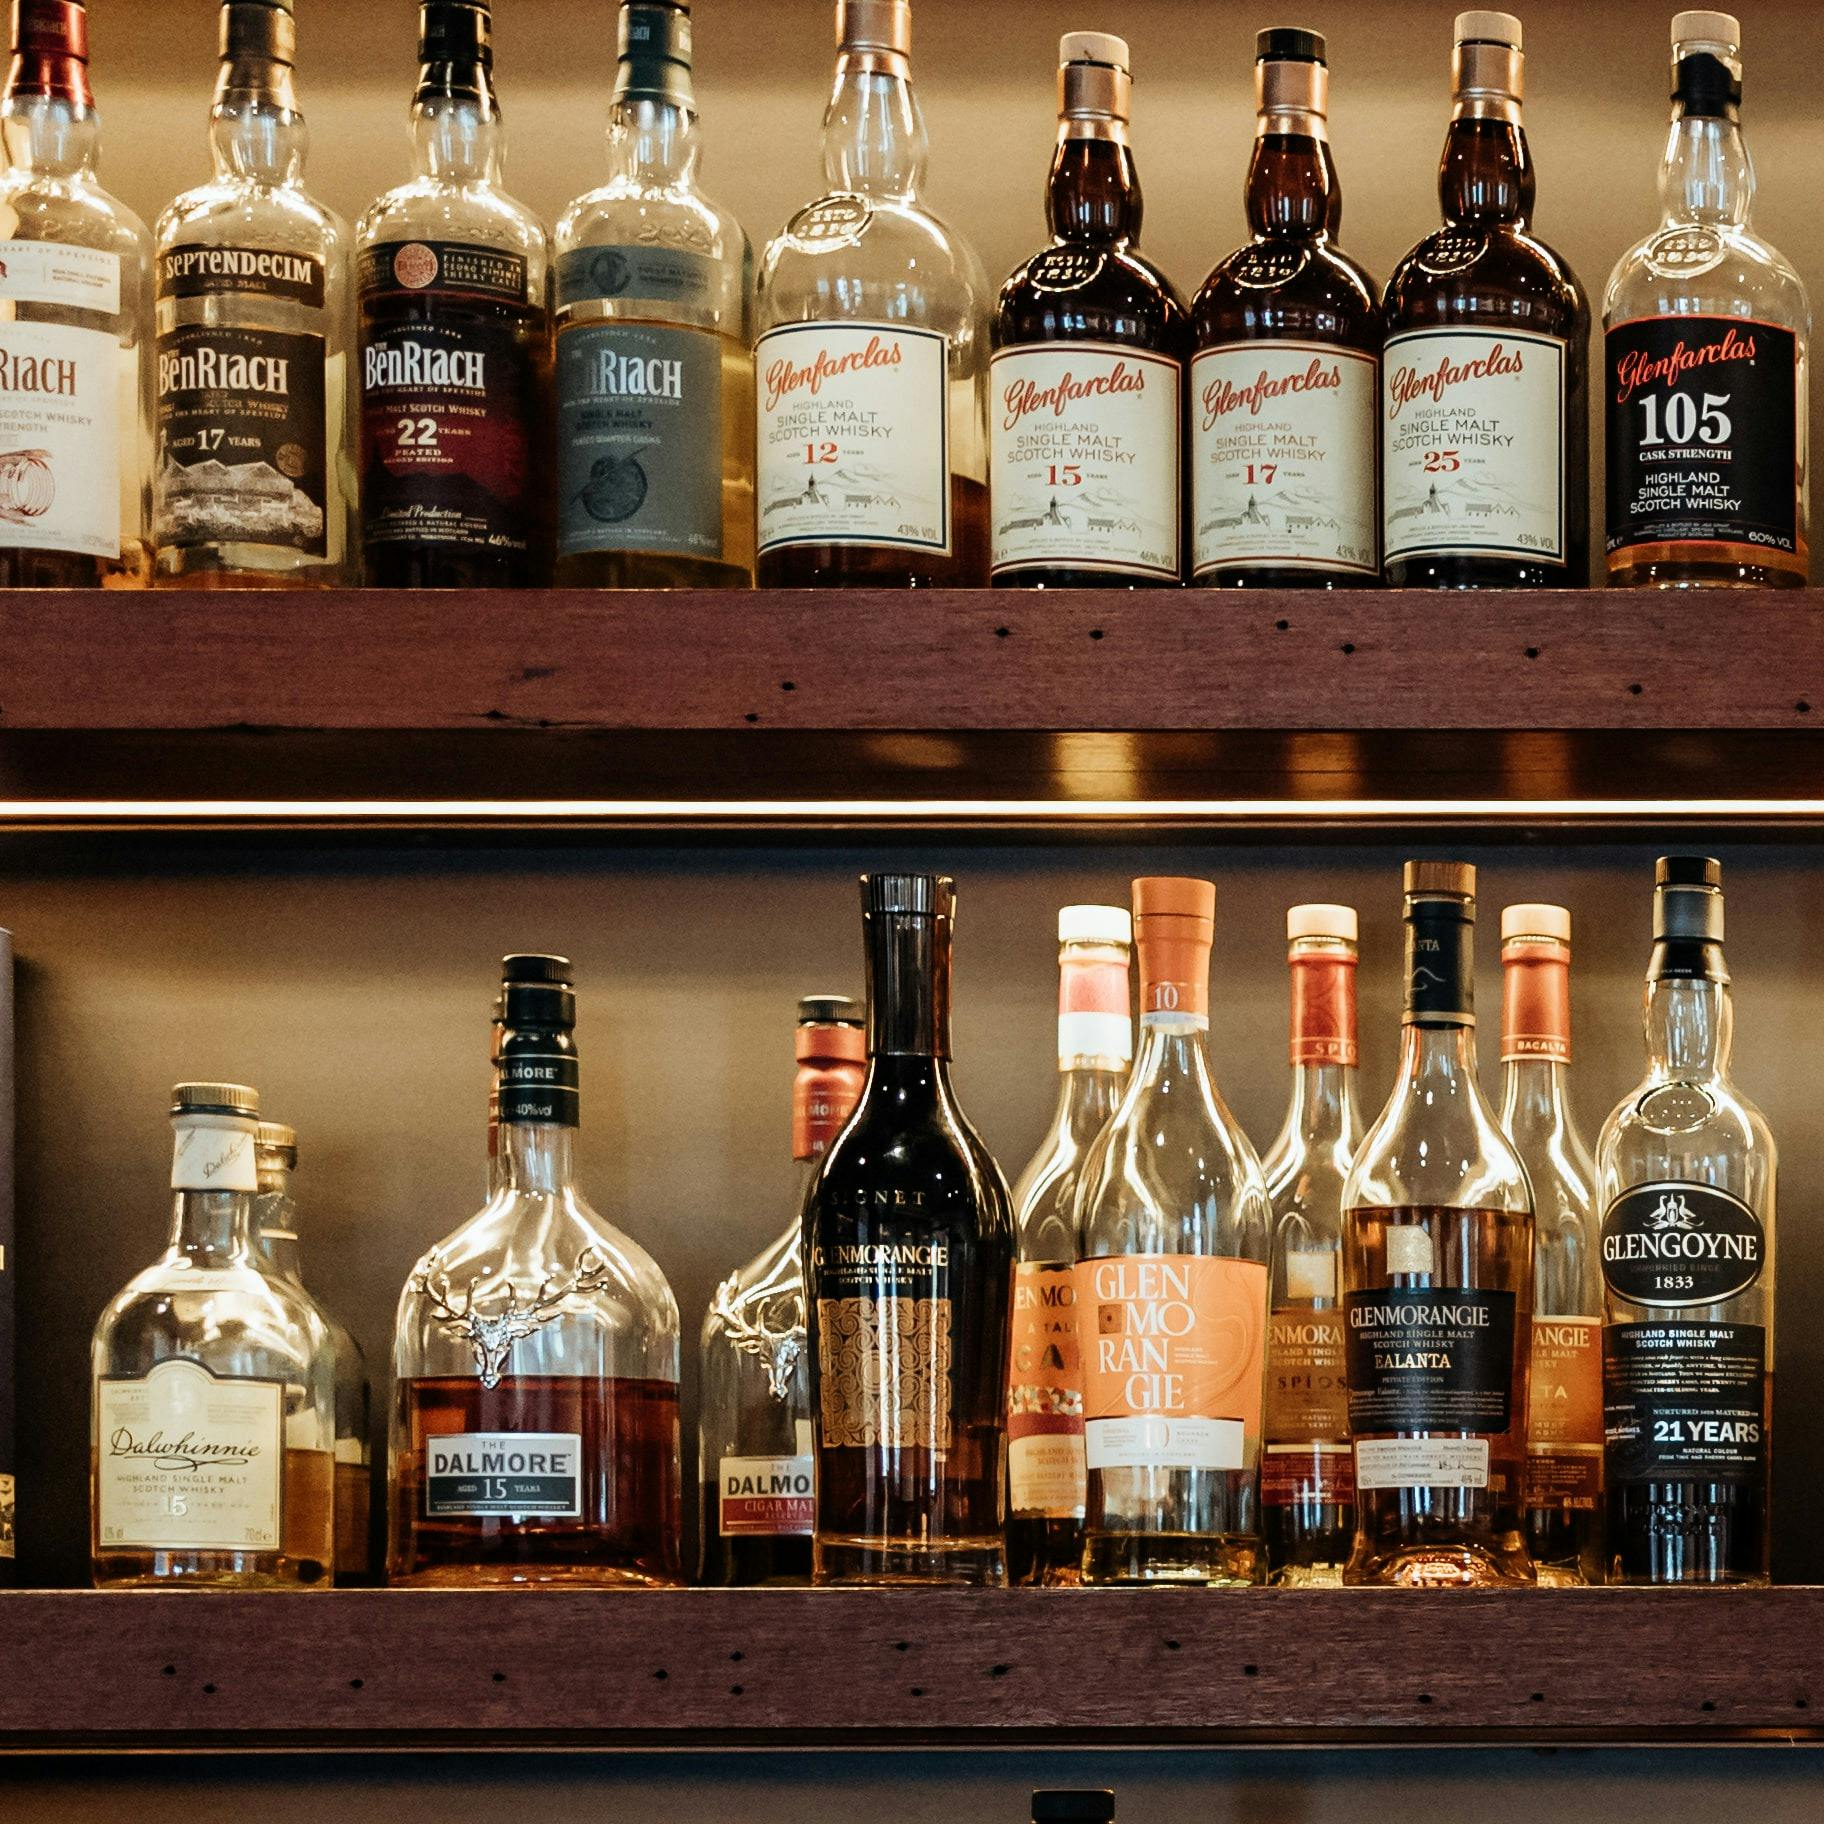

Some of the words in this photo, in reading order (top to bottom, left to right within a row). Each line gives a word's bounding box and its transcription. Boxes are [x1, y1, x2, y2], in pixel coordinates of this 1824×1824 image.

[766, 336, 902, 414] Glenfarclas
[1617, 328, 1756, 403] Glenfarclas
[1202, 358, 1342, 431] Glenfarclas
[1389, 343, 1524, 420] Glenfarclas
[792, 400, 854, 409] HIGHLAND
[1004, 363, 1145, 431] Glenfarclas
[397, 418, 437, 445] 22
[777, 413, 830, 427] SINGLE
[835, 410, 878, 424] MALT
[1638, 391, 1732, 446] 105
[768, 426, 825, 442] SCOTCH
[829, 424, 893, 439] WHISKY
[805, 443, 838, 465] 12
[1424, 451, 1461, 473] 25
[1639, 449, 1666, 461] CASK
[1668, 449, 1732, 460] STRENGTH
[1046, 465, 1083, 486] 15
[1243, 464, 1278, 485] 17
[1604, 1234, 1757, 1262] GLENGOYNE
[1096, 1264, 1189, 1300] GLEN
[1655, 1275, 1694, 1289] 1833
[1126, 1303, 1195, 1336] MO
[1351, 1304, 1489, 1330] GLENMORANGIE
[1098, 1337, 1168, 1374] RAN
[1375, 1351, 1452, 1370] EALANTA
[1125, 1375, 1185, 1409] GIE
[110, 1426, 261, 1458] Dalwhinnie
[1654, 1420, 1683, 1443] 21
[1688, 1422, 1759, 1444] YEARS
[434, 1453, 567, 1475] DALMORE
